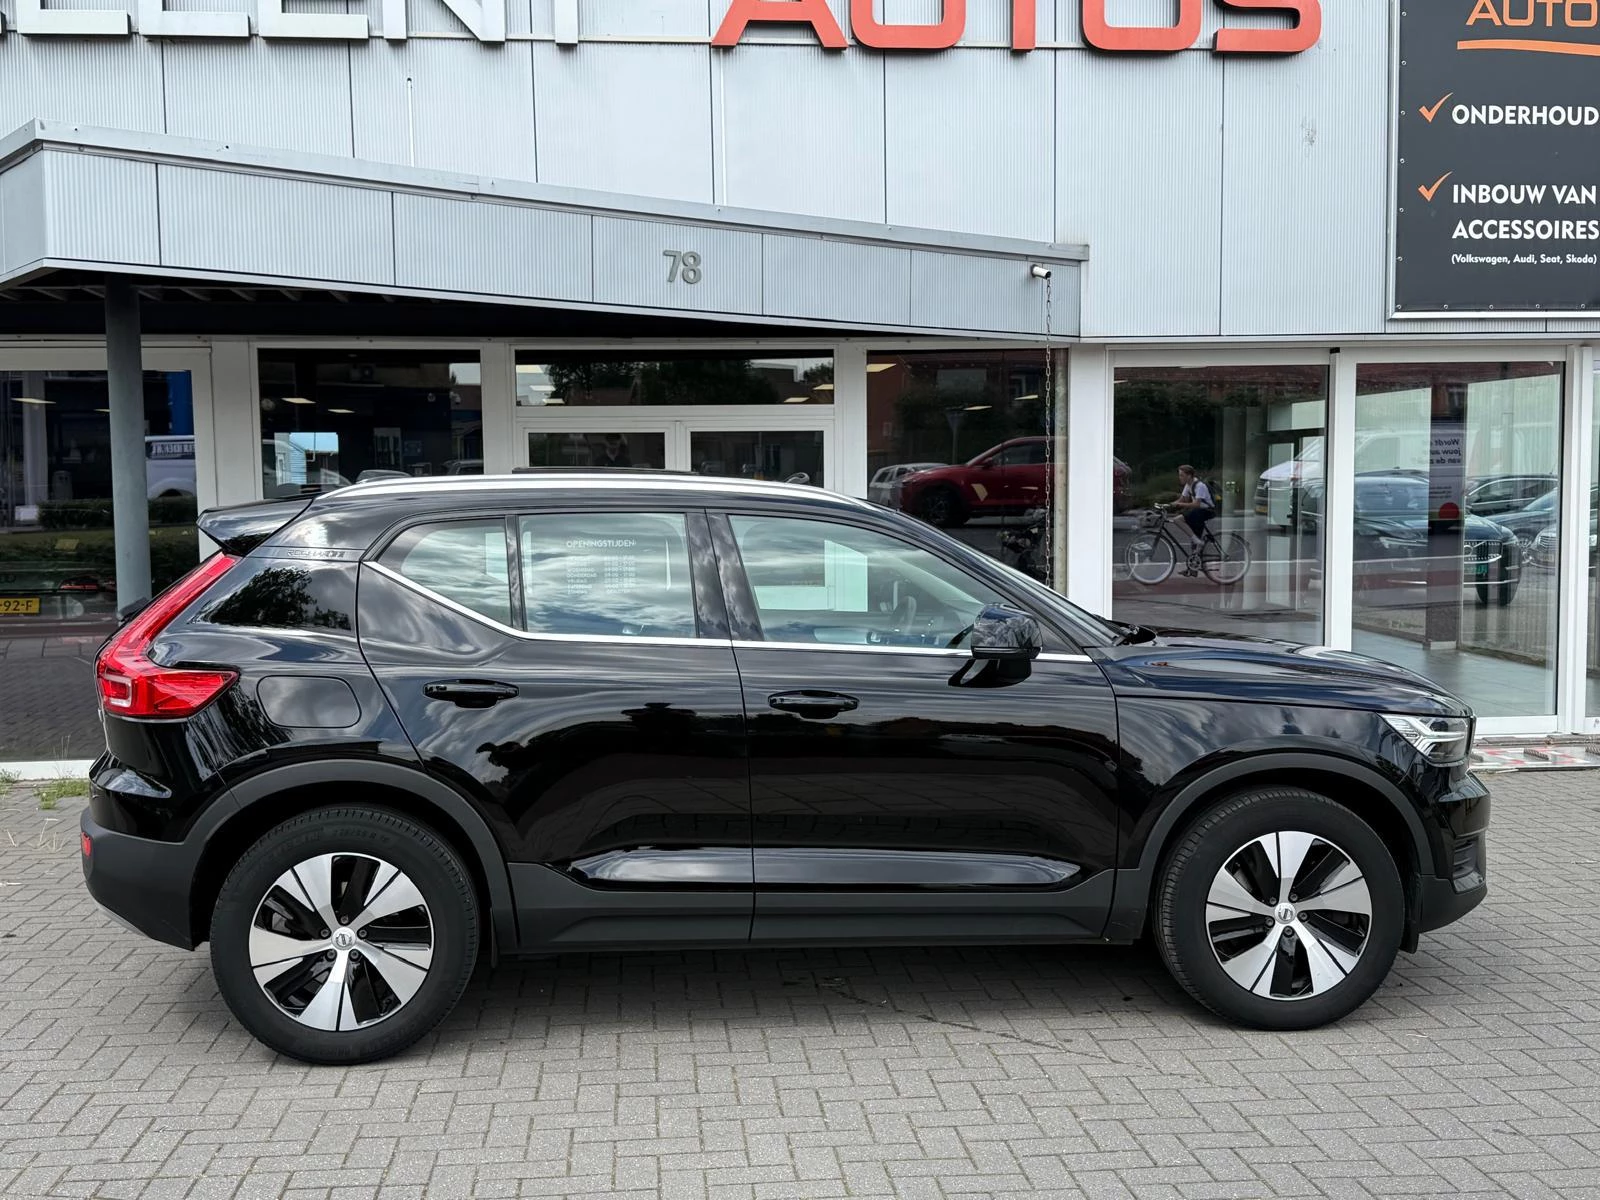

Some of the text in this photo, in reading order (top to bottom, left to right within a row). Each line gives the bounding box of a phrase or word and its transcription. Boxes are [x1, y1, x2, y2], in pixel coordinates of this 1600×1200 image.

[1452, 104, 1600, 126] ONDERHOUD
[1453, 184, 1597, 204] INBOUW VAN
[1452, 219, 1600, 240] ACCESSOIRES
[663, 250, 702, 284] 78
[1451, 253, 1597, 265] (Volkswagen, Audi, Seat, Skoda)
